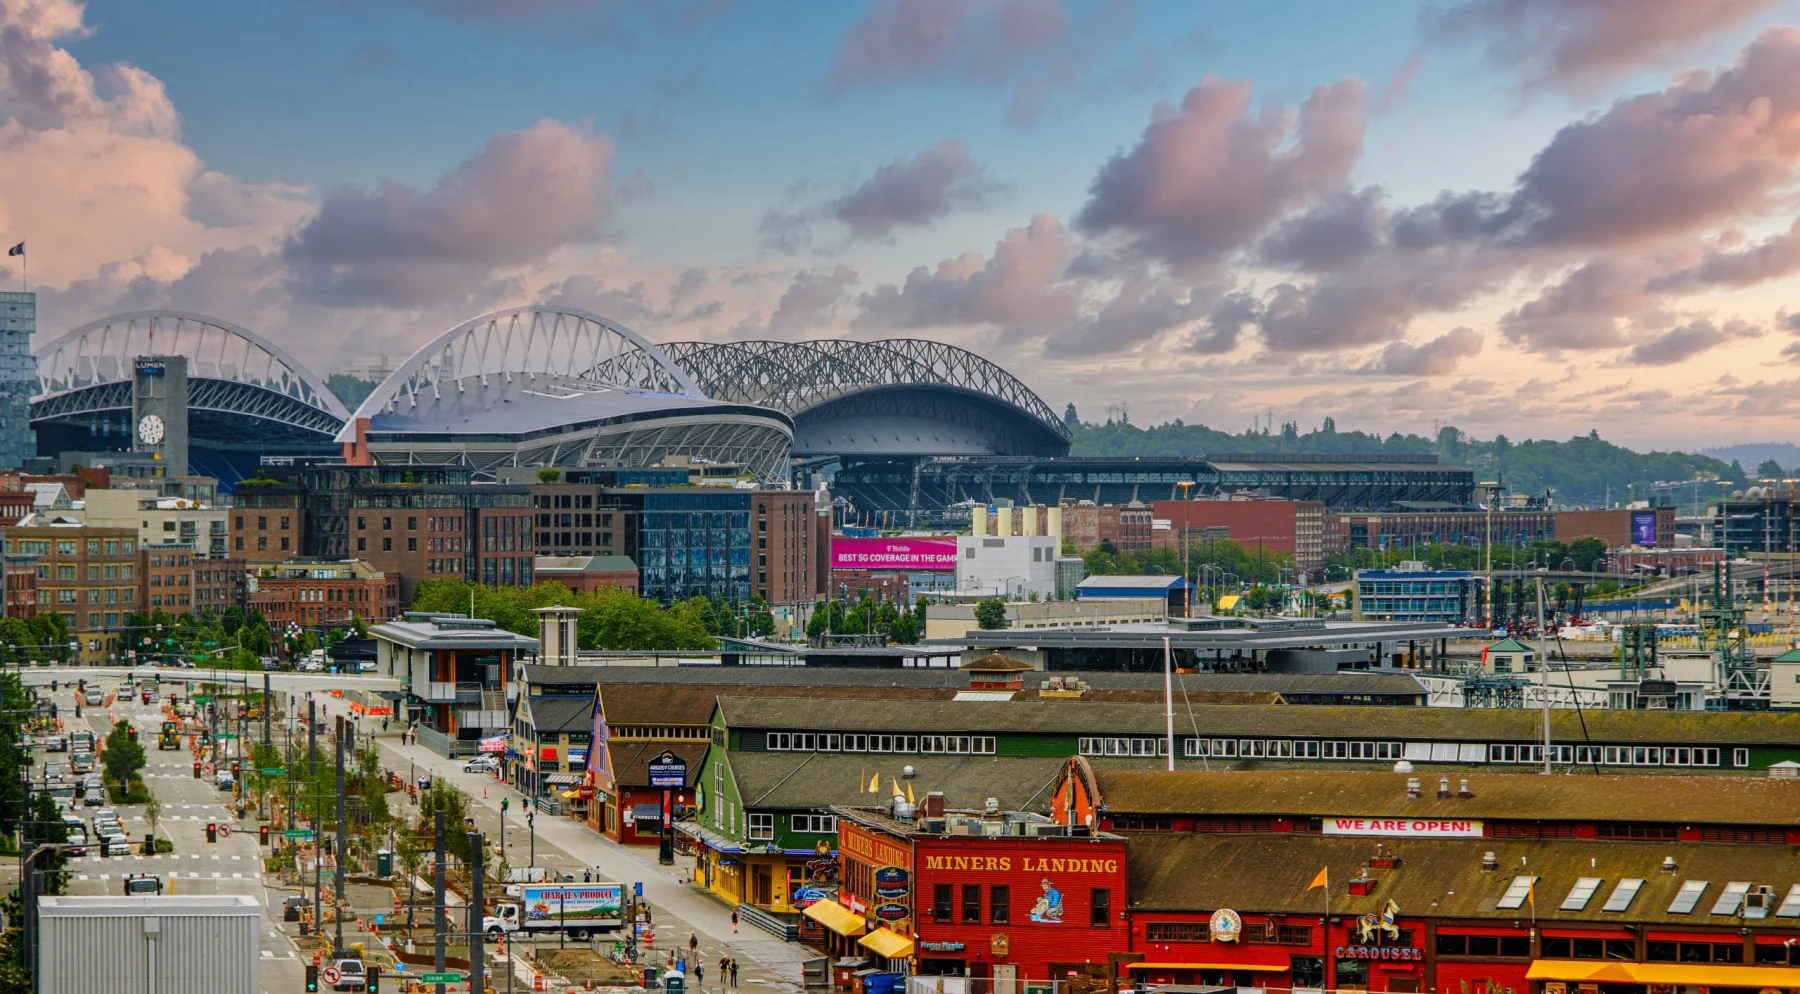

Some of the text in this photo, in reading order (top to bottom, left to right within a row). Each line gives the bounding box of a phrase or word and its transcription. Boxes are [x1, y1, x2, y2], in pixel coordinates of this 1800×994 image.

[838, 553, 857, 562] BEST
[858, 553, 869, 562] 5G
[869, 553, 910, 562] COVERAGE
[910, 554, 919, 562] IN
[920, 554, 935, 562] THE
[1335, 819, 1472, 832] WE ARE OPEN!
[847, 831, 904, 869] MINERS LANDING
[925, 855, 1118, 874] MINERS LANDING
[540, 891, 613, 900] CHARIE'S PRODUCE
[1335, 946, 1422, 961] CAROUSEL
